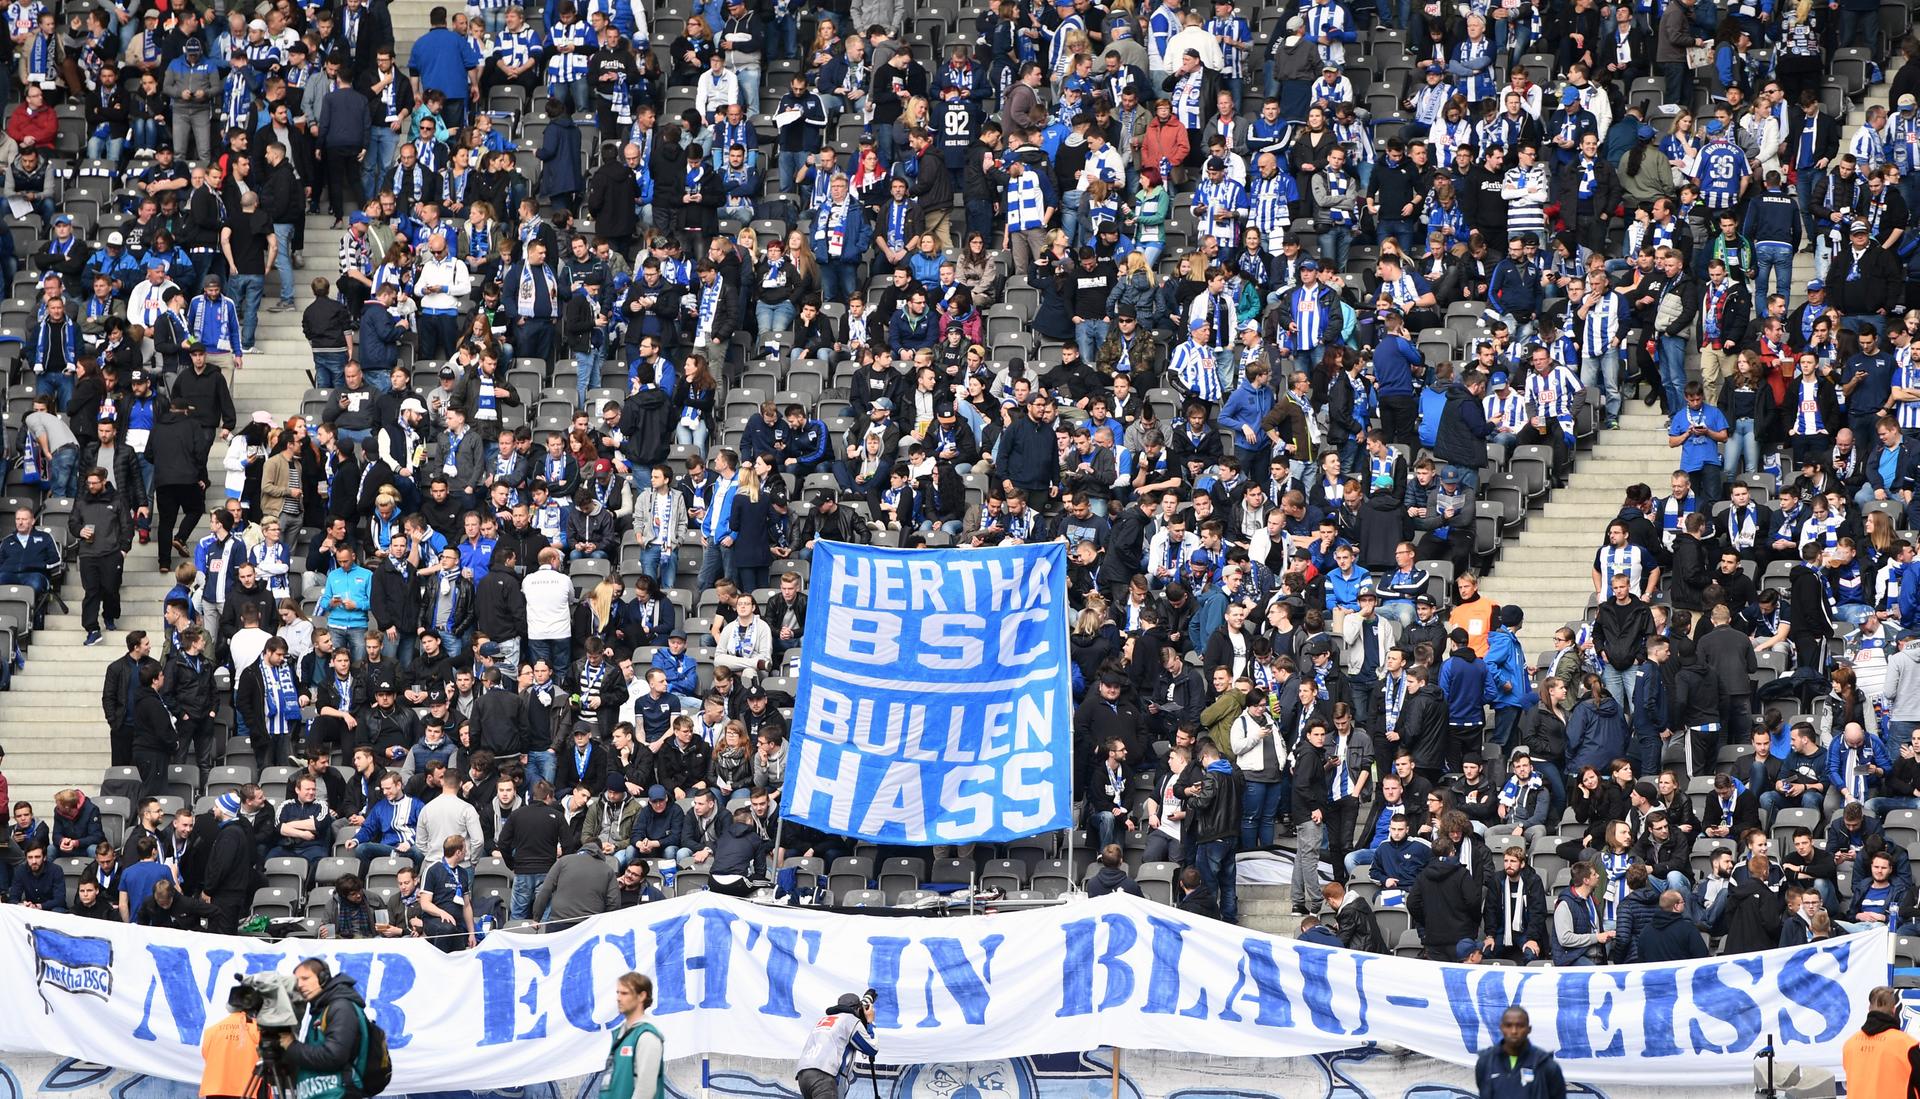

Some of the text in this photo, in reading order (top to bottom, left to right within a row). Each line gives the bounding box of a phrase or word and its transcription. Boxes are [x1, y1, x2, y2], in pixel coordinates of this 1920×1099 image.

[945, 111, 970, 135] 92
[1705, 143, 1739, 155] HERTHA BSC
[1710, 155, 1734, 179] 36
[1763, 196, 1791, 204] BERLIN
[1298, 301, 1314, 311] DB
[1203, 359, 1215, 368] DB
[1540, 391, 1555, 402] DB
[1802, 401, 1816, 411] DB
[829, 555, 1051, 611] HERTHA
[825, 605, 1049, 669] BSC
[805, 684, 1054, 762] BULLEN
[790, 739, 1056, 842] HASS
[83, 969, 107, 992] BSC
[132, 908, 1852, 1059] NR ECHT IN BLAU-WEISS
